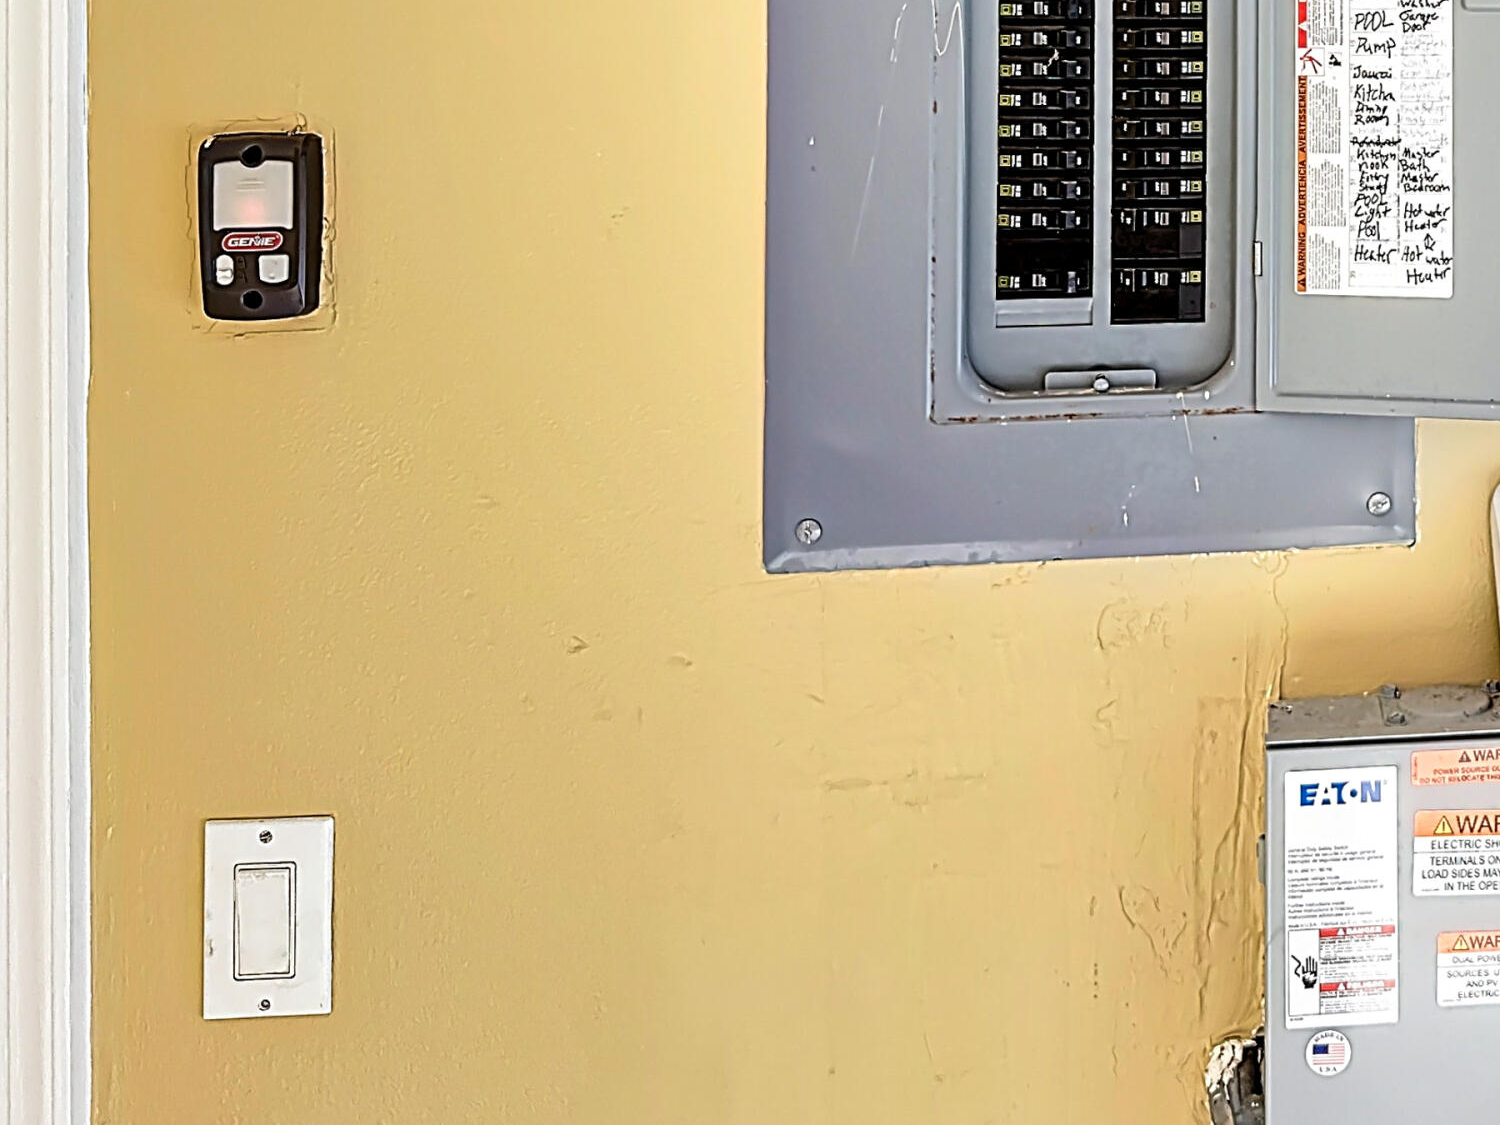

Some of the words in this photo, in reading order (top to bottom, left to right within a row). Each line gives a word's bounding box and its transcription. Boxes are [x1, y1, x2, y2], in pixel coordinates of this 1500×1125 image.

[1298, 75, 1307, 153] AVERTISSEMENT
[1298, 160, 1306, 225] ADVERTENCIA
[228, 236, 276, 247] GENIE
[1297, 231, 1306, 276] WARNING
[1354, 244, 1397, 264] Heater
[1431, 839, 1481, 850] ELECTRIC
[1430, 856, 1485, 866] TERMINALS
[1422, 869, 1449, 879] LOAD
[1451, 869, 1480, 878] SIDES
[1444, 882, 1454, 891] IN
[1456, 881, 1476, 890] THE
[1458, 989, 1499, 999] ELECTRIC
